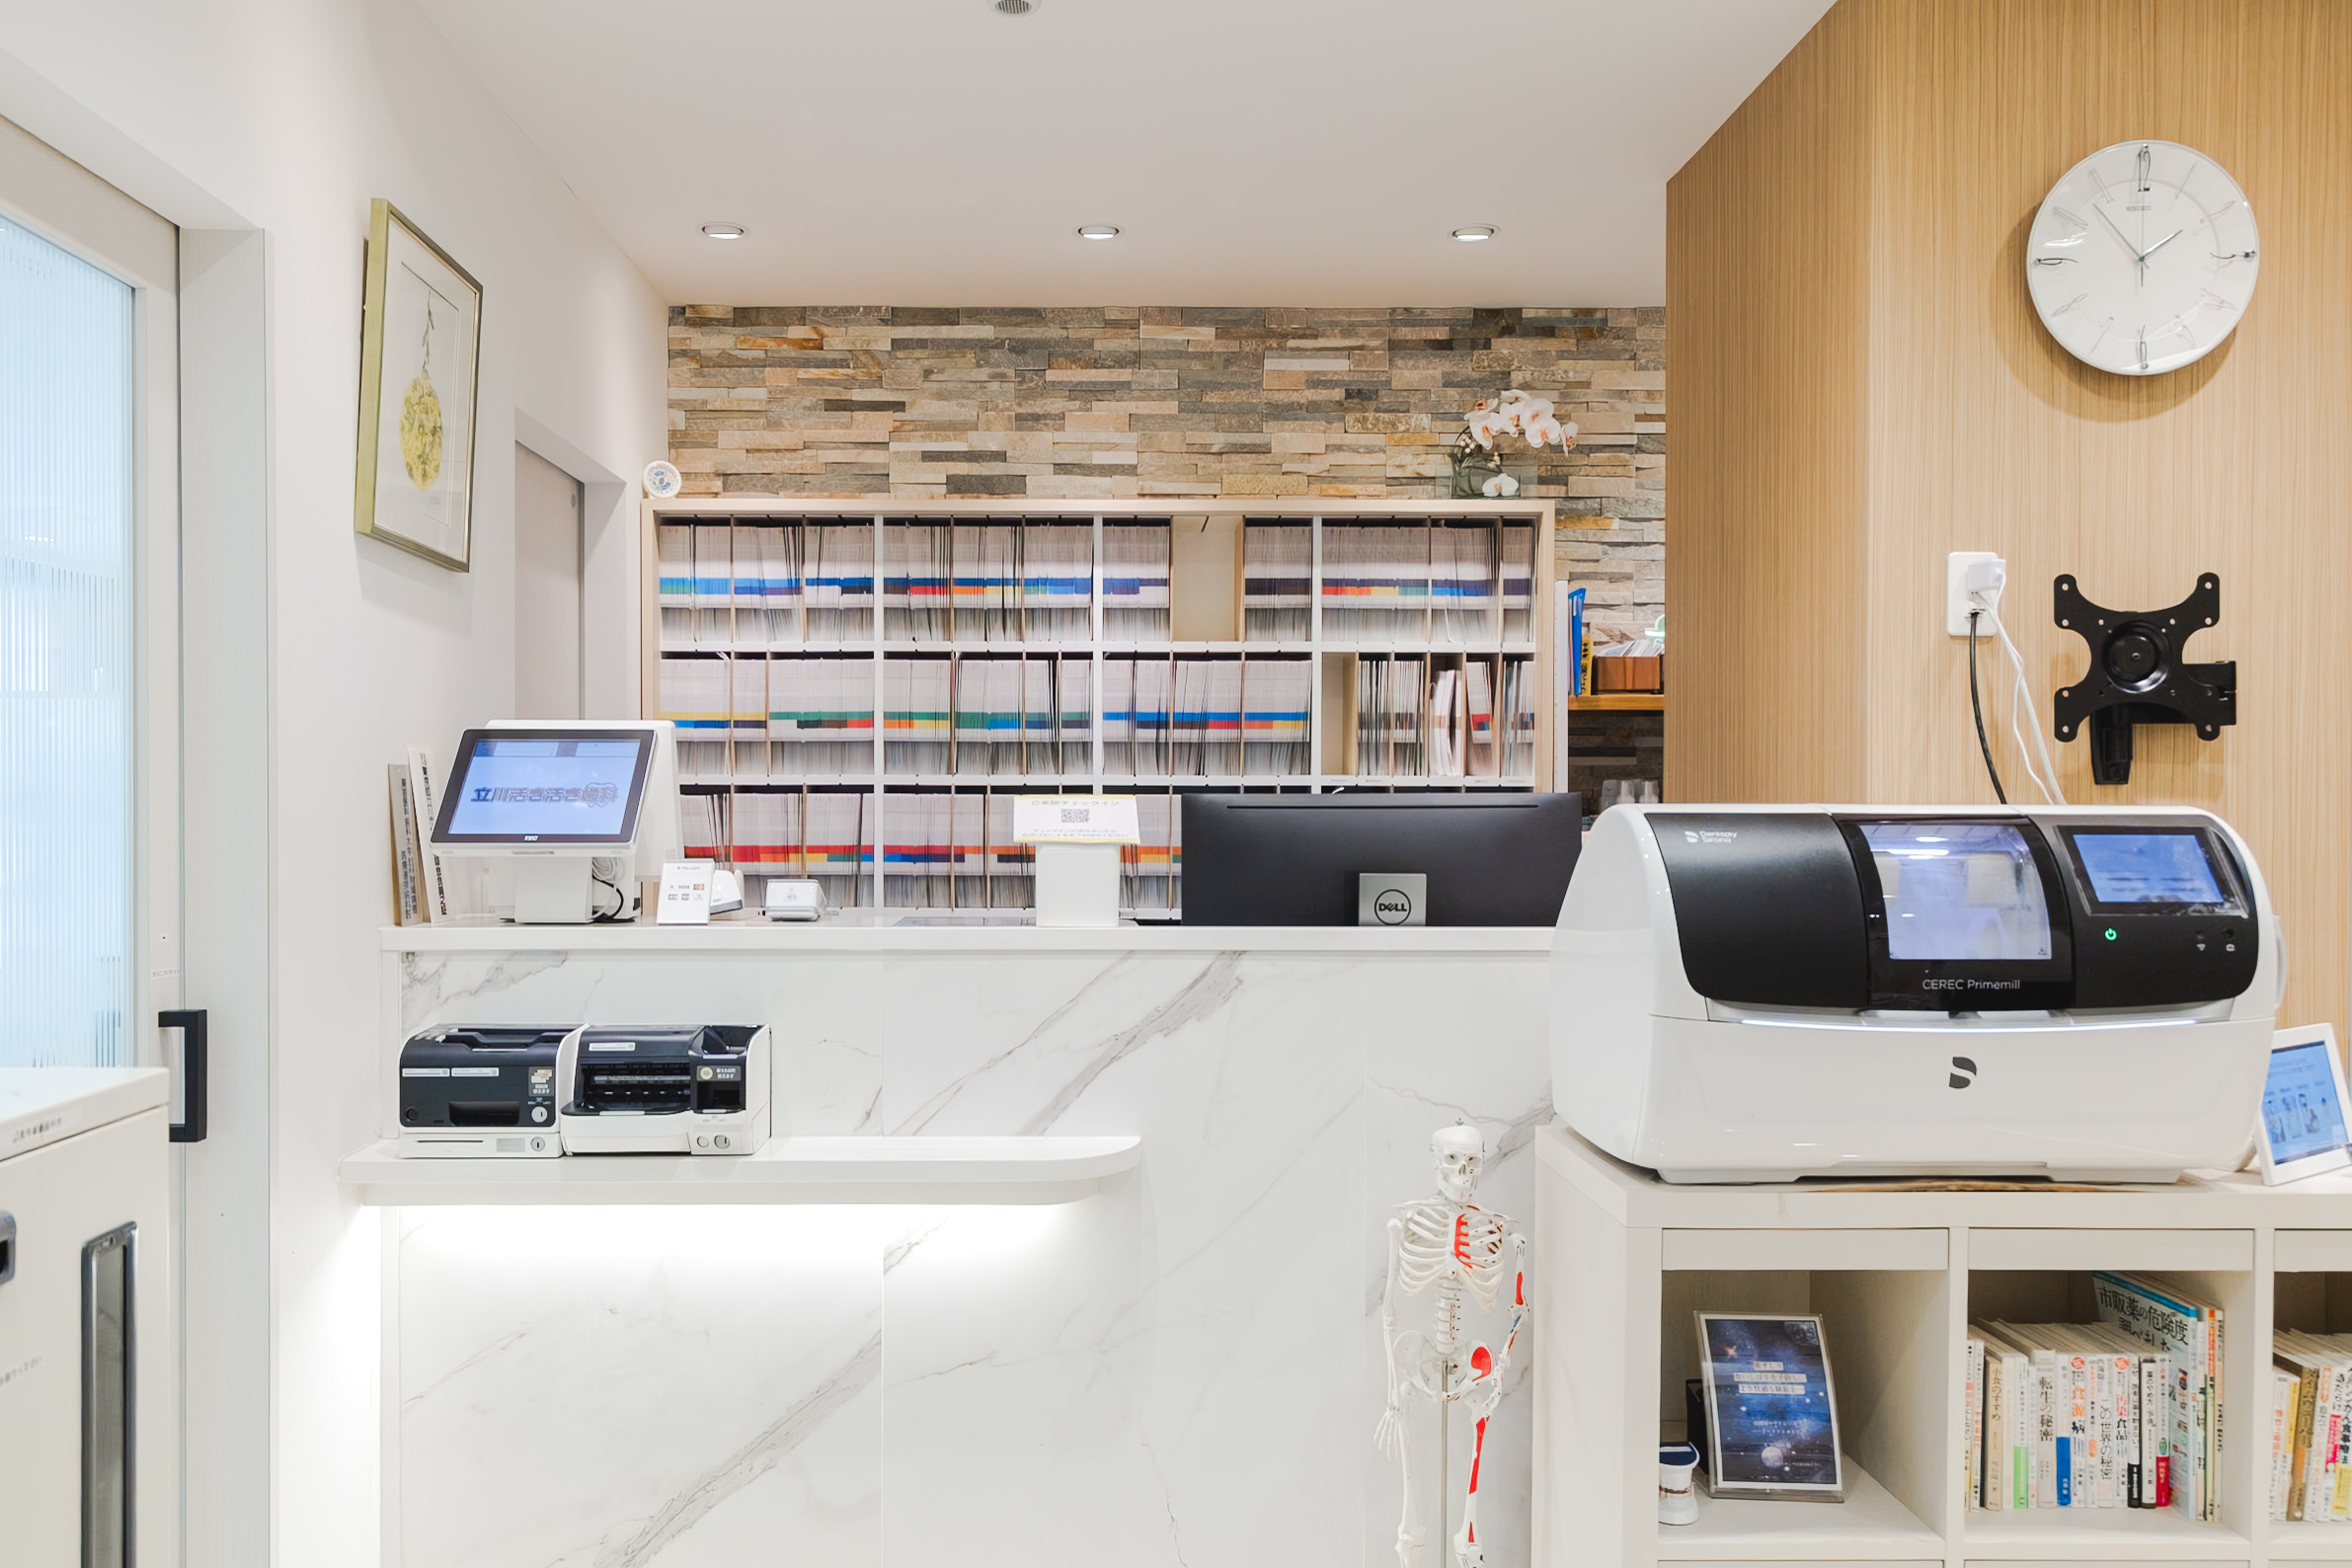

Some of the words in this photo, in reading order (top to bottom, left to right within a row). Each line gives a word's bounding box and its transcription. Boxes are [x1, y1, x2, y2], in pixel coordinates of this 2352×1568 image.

[2138, 150, 2152, 192] 12
[1378, 902, 1407, 912] DELL
[1922, 980, 1964, 990] CEREC
[1967, 980, 2021, 989] Primemill
[2098, 1286, 2188, 1346] 市販薬の危険度
[1991, 1368, 2002, 1421] 小食のすすめ
[2039, 1375, 2054, 1442] 転生の秘密
[2100, 1398, 2113, 1480] この世界の秘密
